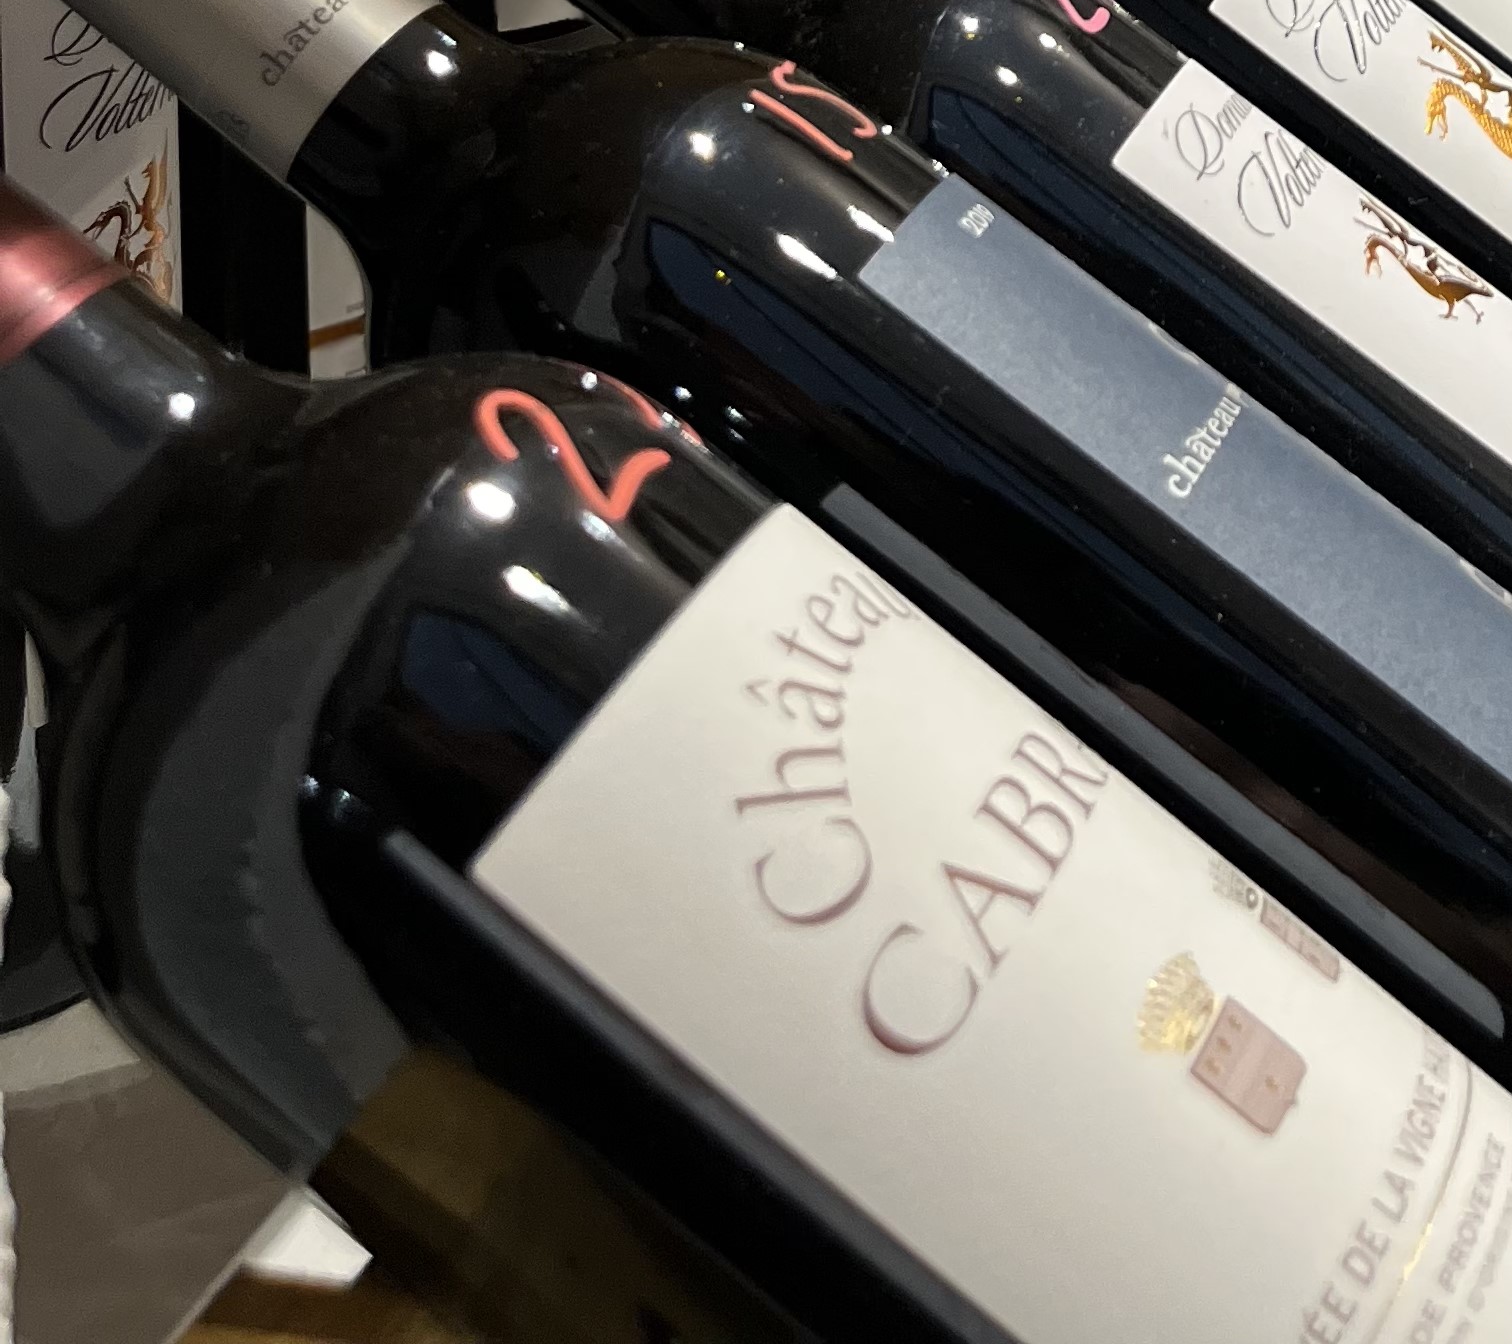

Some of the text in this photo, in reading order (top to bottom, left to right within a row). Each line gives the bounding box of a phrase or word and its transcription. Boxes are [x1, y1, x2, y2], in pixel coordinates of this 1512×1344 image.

[734, 568, 922, 927] Château
[1392, 1072, 1447, 1166] VIGNE
[1371, 1169, 1416, 1225] LA
[1340, 1219, 1392, 1288] DE
